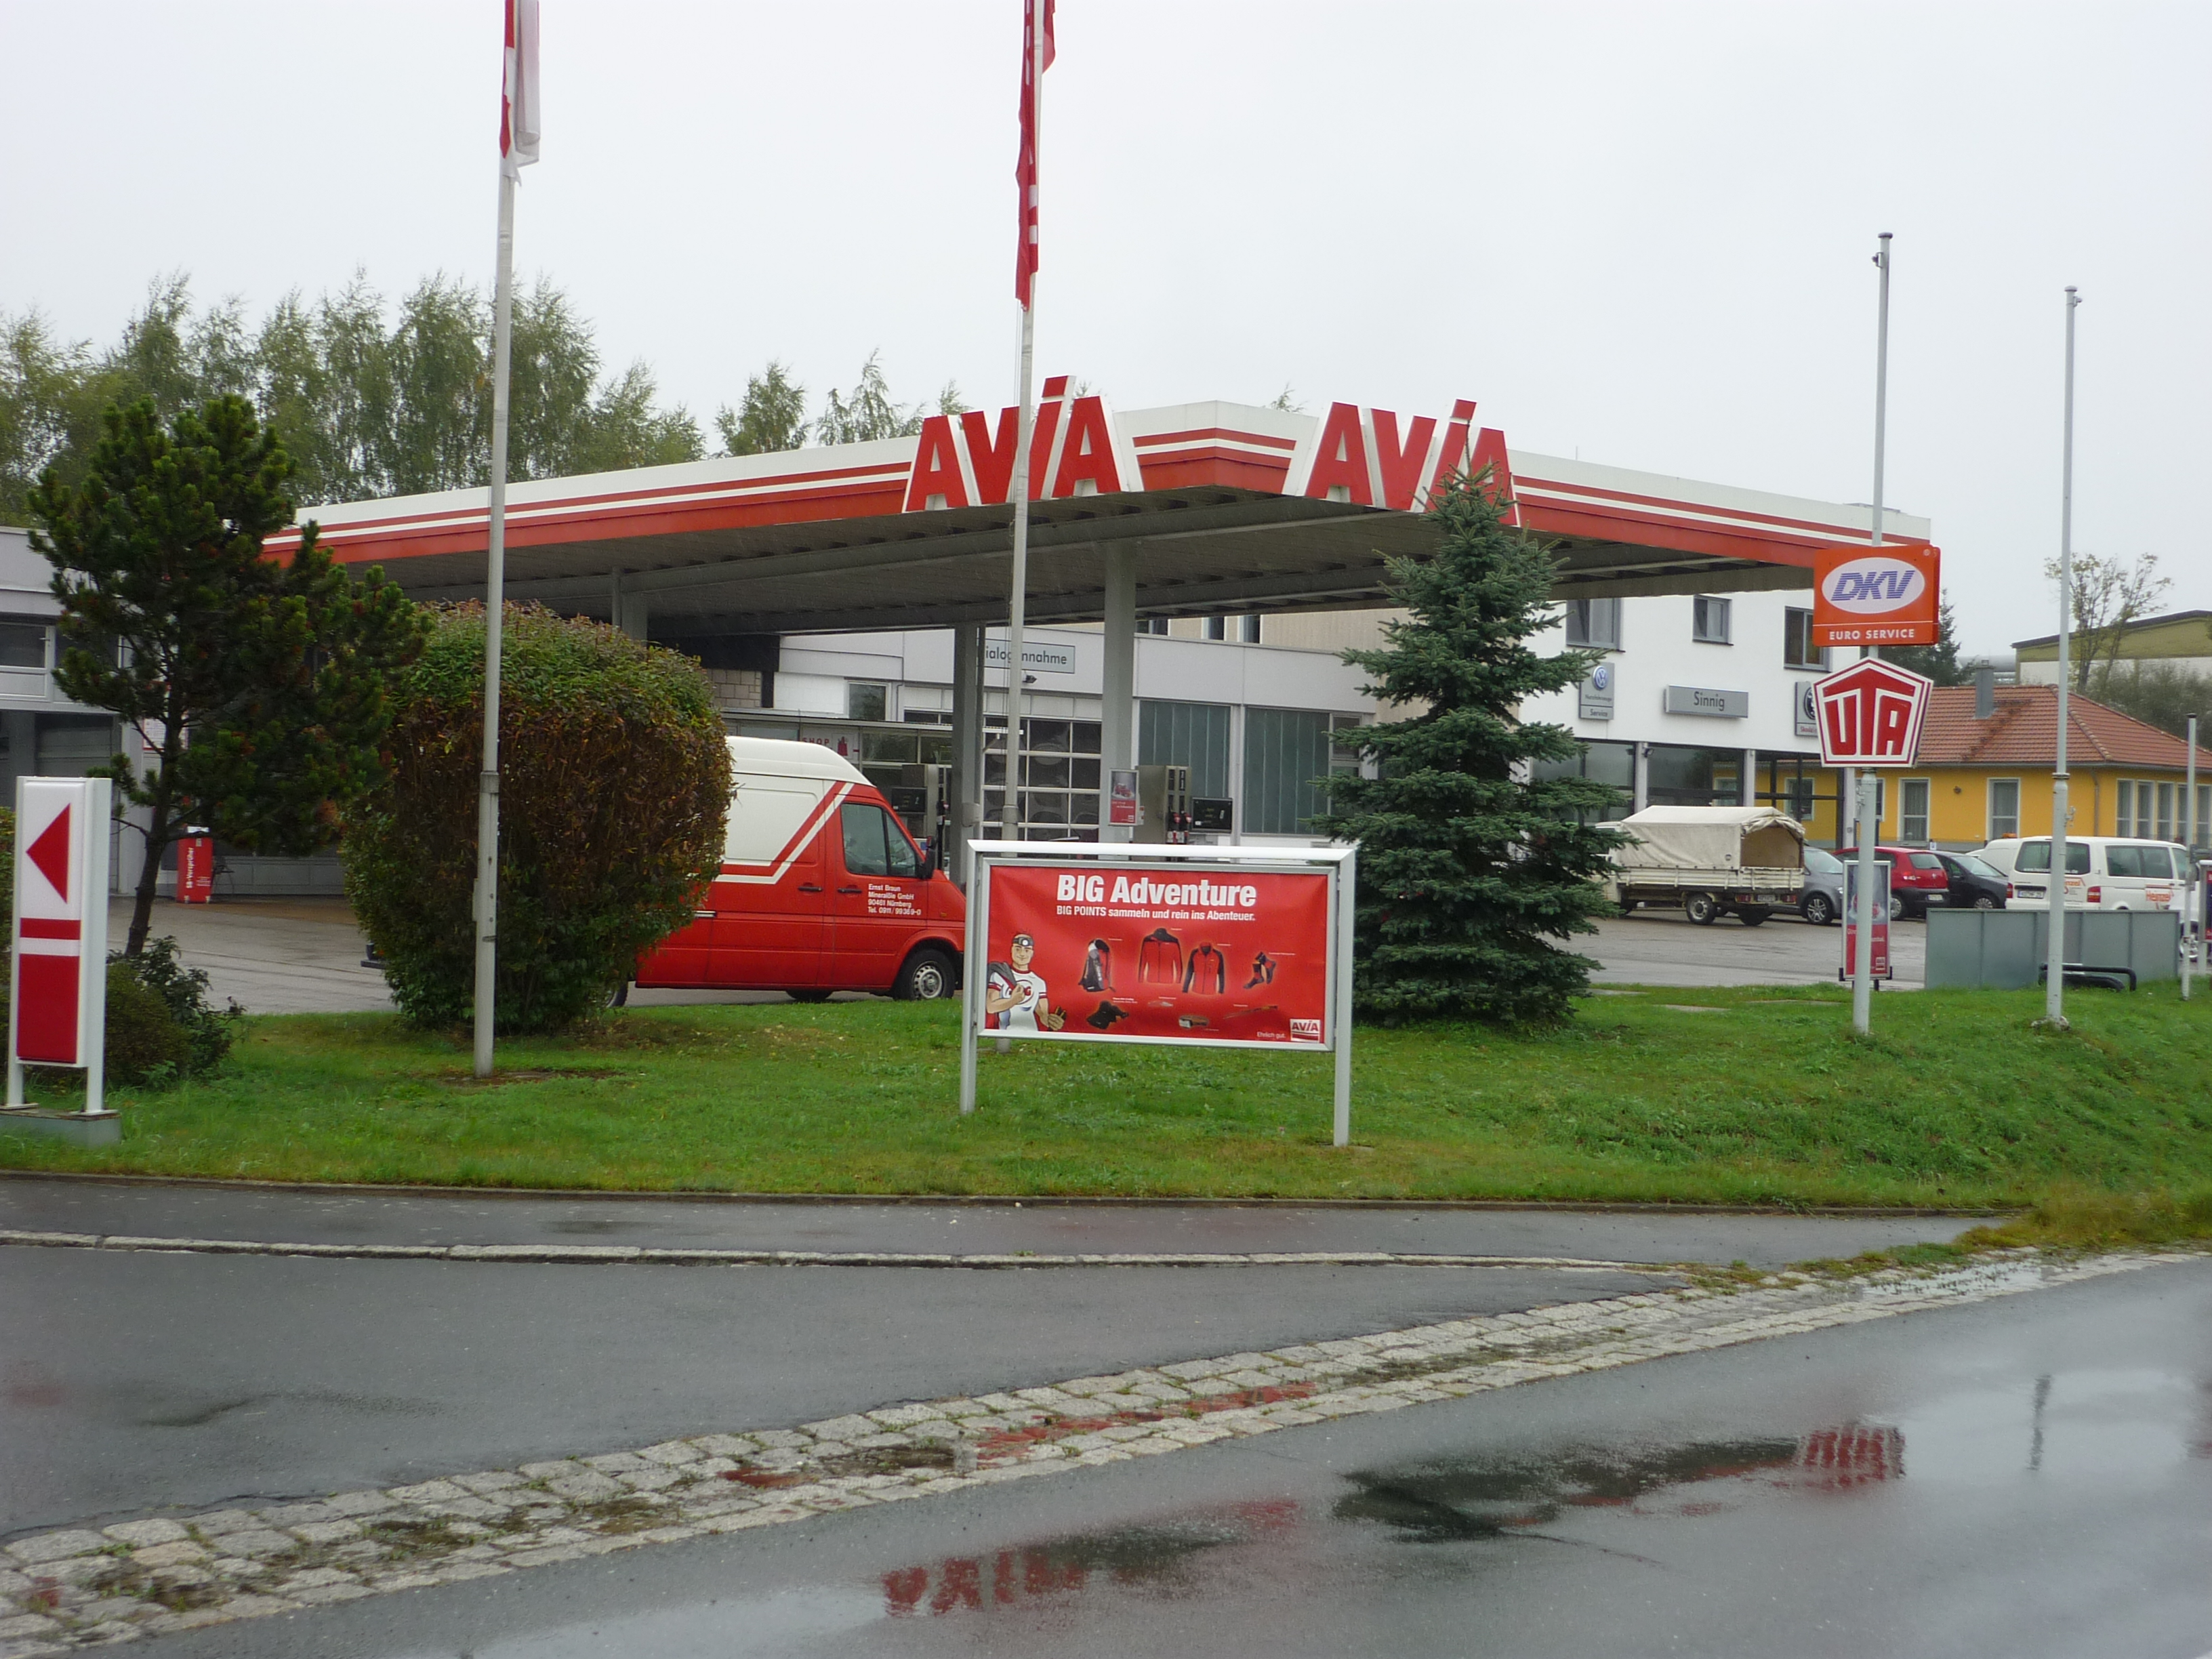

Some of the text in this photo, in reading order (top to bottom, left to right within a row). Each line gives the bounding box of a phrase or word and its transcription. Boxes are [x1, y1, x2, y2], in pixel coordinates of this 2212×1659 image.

[905, 375, 1122, 512] AVIA
[1305, 398, 1519, 527] AVIA
[1830, 570, 1916, 602] DKV
[1829, 628, 1915, 640] EURO SERVICE
[1694, 691, 1725, 712] Sinnig
[1590, 708, 1608, 717] Service
[1823, 667, 1917, 756] UTA
[802, 737, 830, 746] SHOP
[868, 883, 884, 891] Ernst
[1057, 874, 1256, 907] BIG Adventure
[868, 891, 896, 899] Mineralöle
[886, 900, 912, 909] Nürnberg
[1057, 905, 1256, 921] BIG POINTS sammeln und rein ins Abenteuer.
[1292, 1020, 1319, 1031] AVIA
